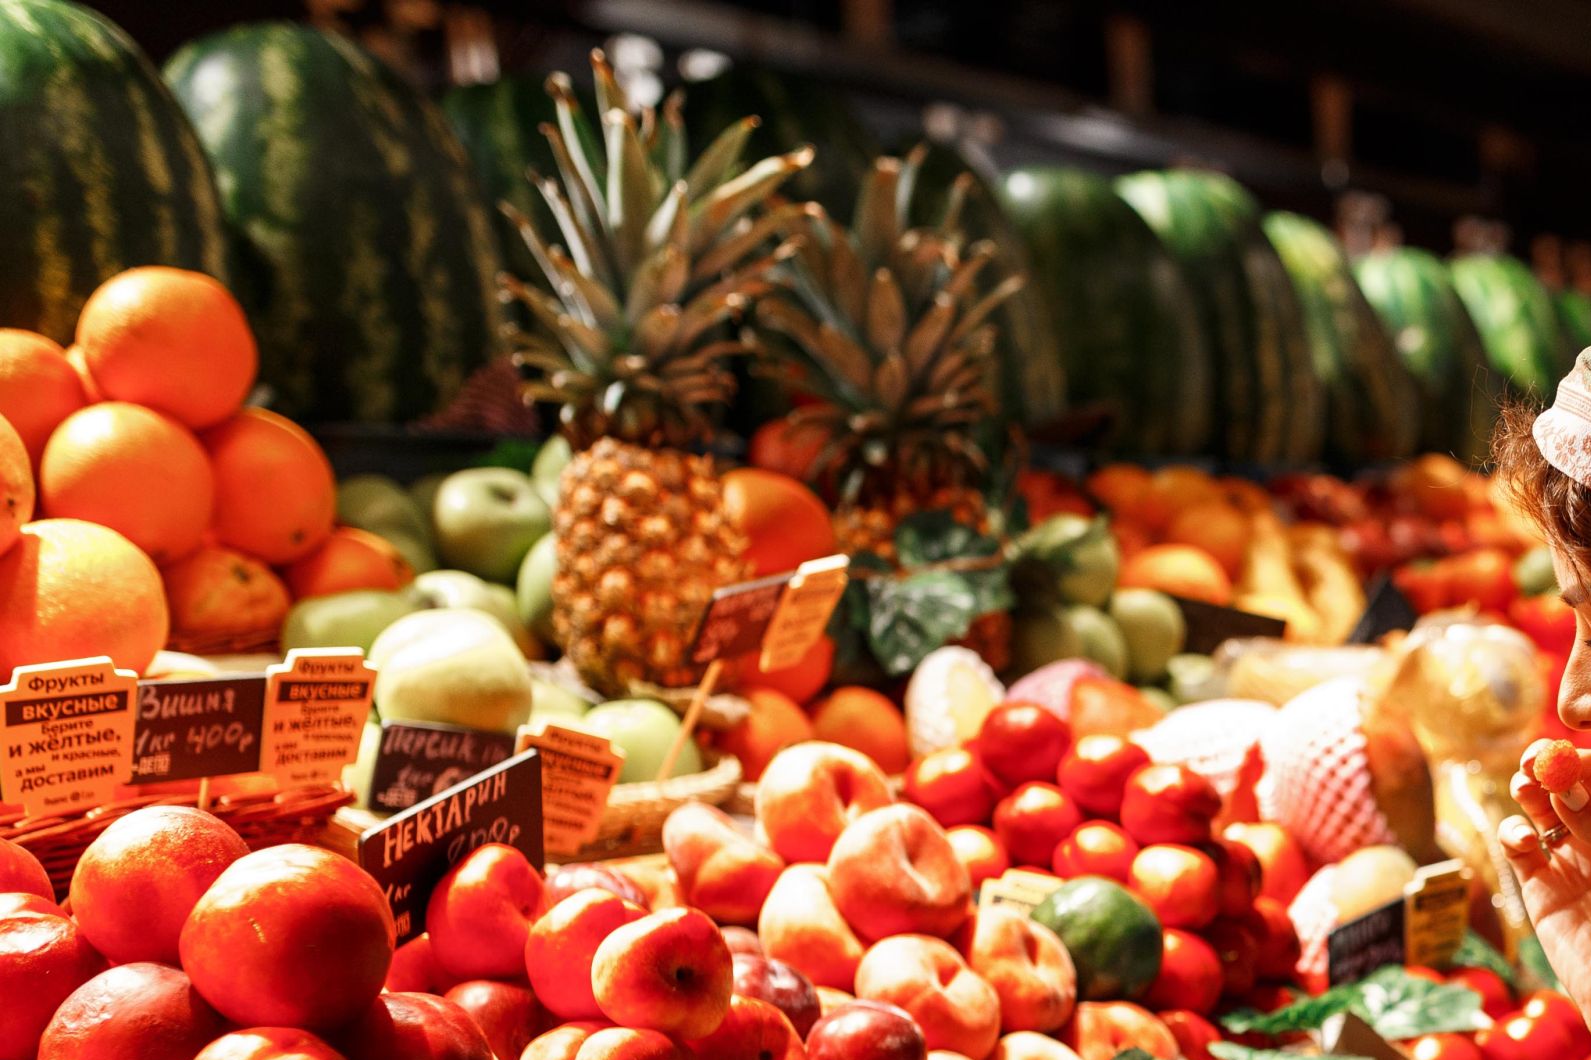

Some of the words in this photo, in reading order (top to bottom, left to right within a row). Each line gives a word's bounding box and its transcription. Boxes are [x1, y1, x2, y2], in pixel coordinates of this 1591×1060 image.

[28, 673, 105, 693] Фрукты
[21, 694, 119, 720] вкусные
[41, 718, 94, 736] Берите
[9, 745, 22, 759] и
[29, 727, 121, 755] жёлтые,
[20, 763, 114, 793] доставим
